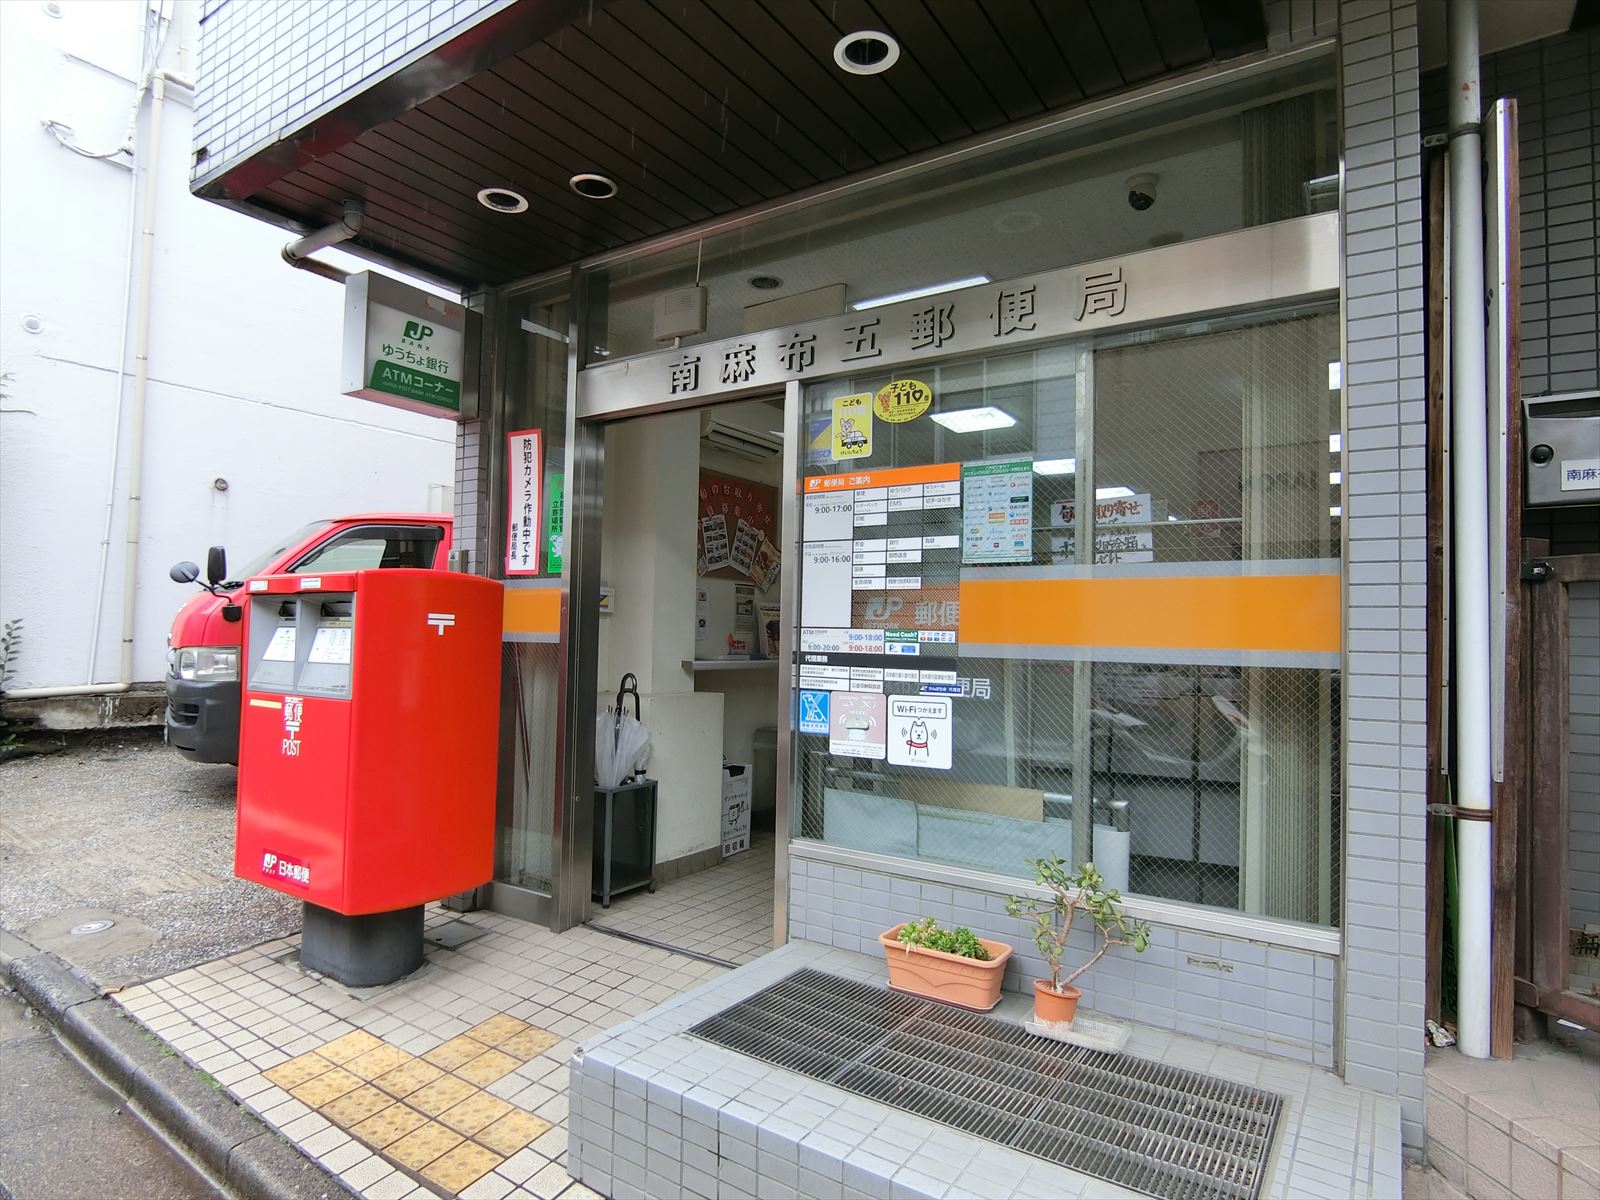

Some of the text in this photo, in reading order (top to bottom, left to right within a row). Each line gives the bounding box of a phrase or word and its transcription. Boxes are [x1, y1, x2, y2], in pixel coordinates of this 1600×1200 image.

[669, 267, 1127, 393] 南麻布五郵便局
[382, 343, 449, 374] ゆうちょ銀行
[382, 367, 454, 393] ATMコーナー
[889, 382, 917, 394] 子ども
[842, 399, 862, 407] こども
[848, 475, 870, 486] ご案内
[1566, 467, 1600, 482] 南麻
[521, 438, 532, 566] 防犯カメラ作動中です
[815, 504, 852, 514] 9:00-17:00
[814, 554, 851, 565] 9:00-16:00
[848, 634, 882, 642] 9:00-18:00
[808, 645, 839, 653] 9:00-20:00
[848, 645, 882, 654] 9:00-18:00
[284, 702, 303, 724] 郵便
[282, 738, 302, 757] POST
[279, 860, 310, 884] 日本郵便
